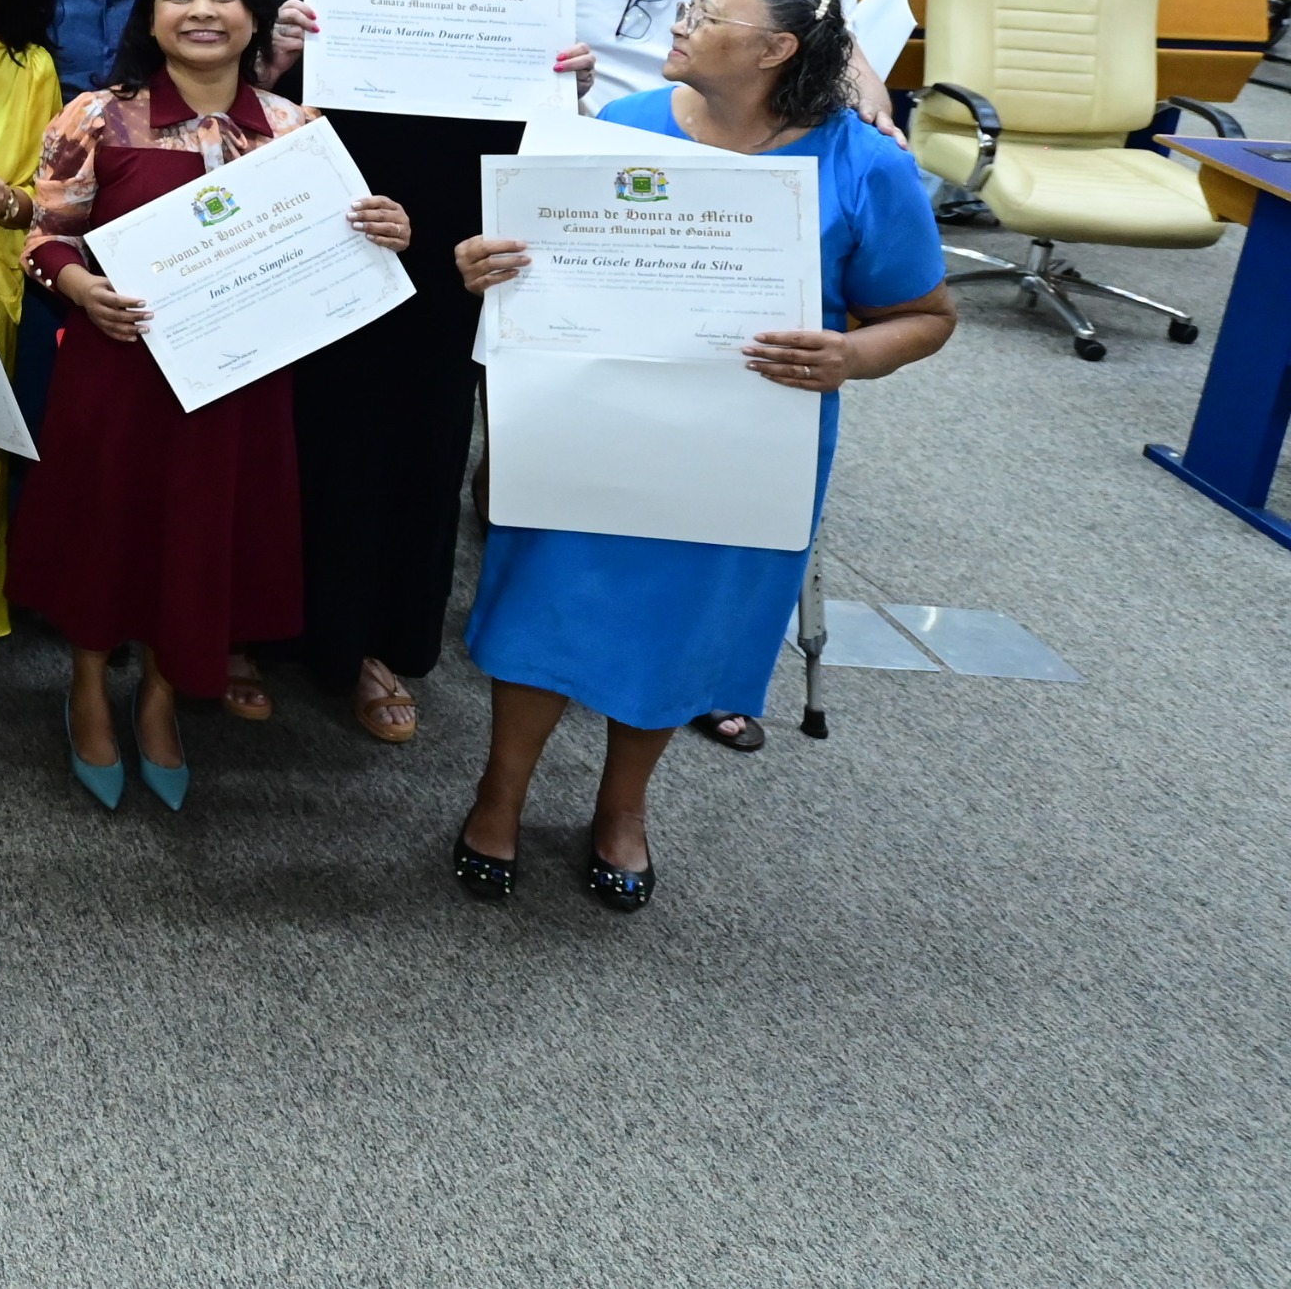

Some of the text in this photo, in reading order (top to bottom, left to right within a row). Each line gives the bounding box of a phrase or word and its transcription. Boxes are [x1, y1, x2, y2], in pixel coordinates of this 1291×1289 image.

[408, 0, 454, 11] Municipal
[456, 3, 467, 11] de
[469, 3, 506, 14] Goiânia
[360, 24, 512, 43] Flávia Martins Duarte Santos
[537, 207, 753, 224] Diploma de Honra ao Mérito
[151, 191, 311, 274] Diploma de Honra ao Mérito
[562, 223, 731, 238] Câmara Municipal de Goiânia
[180, 212, 303, 277] Câmara Municipal de Goiânia
[550, 255, 743, 271] Maria Gisele Barbosa da Silva
[209, 247, 304, 300] Inês Alves Simplício
